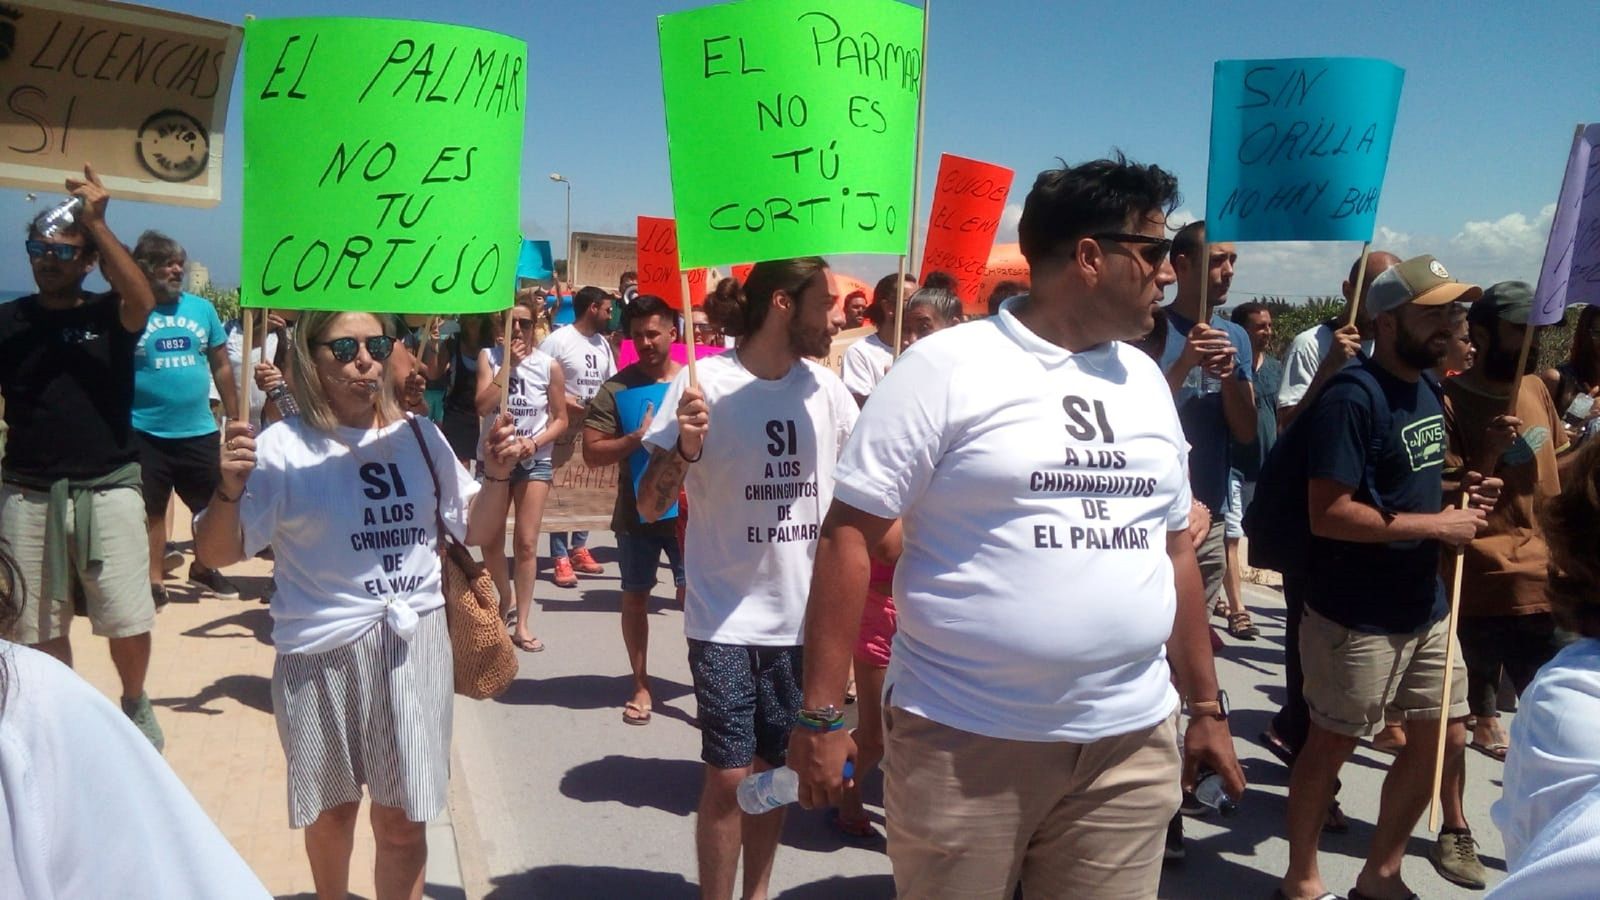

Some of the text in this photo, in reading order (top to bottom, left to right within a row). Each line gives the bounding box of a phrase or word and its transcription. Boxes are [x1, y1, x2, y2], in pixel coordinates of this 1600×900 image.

[30, 20, 226, 99] LICENCIAS
[704, 11, 919, 98] EL PARMAR
[260, 33, 523, 118] EL PALMAR
[1237, 66, 1328, 110] SIN
[7, 85, 77, 155] SI
[758, 93, 887, 134] NO ES
[319, 140, 478, 187] NO ES
[772, 140, 839, 180] TÚ
[376, 193, 434, 229] TU
[1219, 188, 1258, 221] NO
[1264, 180, 1331, 217] HAY
[934, 205, 957, 231] EL
[161, 338, 185, 350] 1892
[155, 354, 196, 369] FITCH
[585, 354, 597, 369] SI
[511, 398, 528, 407] LOS
[1062, 395, 1115, 443] SI
[765, 419, 797, 457] SI
[764, 461, 801, 479] A LOS
[1064, 447, 1127, 469] A LOS
[359, 462, 408, 500] SI
[745, 481, 818, 501] CHIRINGUITOS
[1029, 471, 1157, 498] CHIRINGUITOS
[363, 502, 414, 526] A LOS
[777, 504, 792, 521] DE
[1081, 498, 1110, 520] DE
[747, 524, 818, 543] EL PALMAR
[1033, 525, 1150, 550] EL PALMAR
[382, 553, 403, 573] DE
[363, 578, 388, 597] EL
